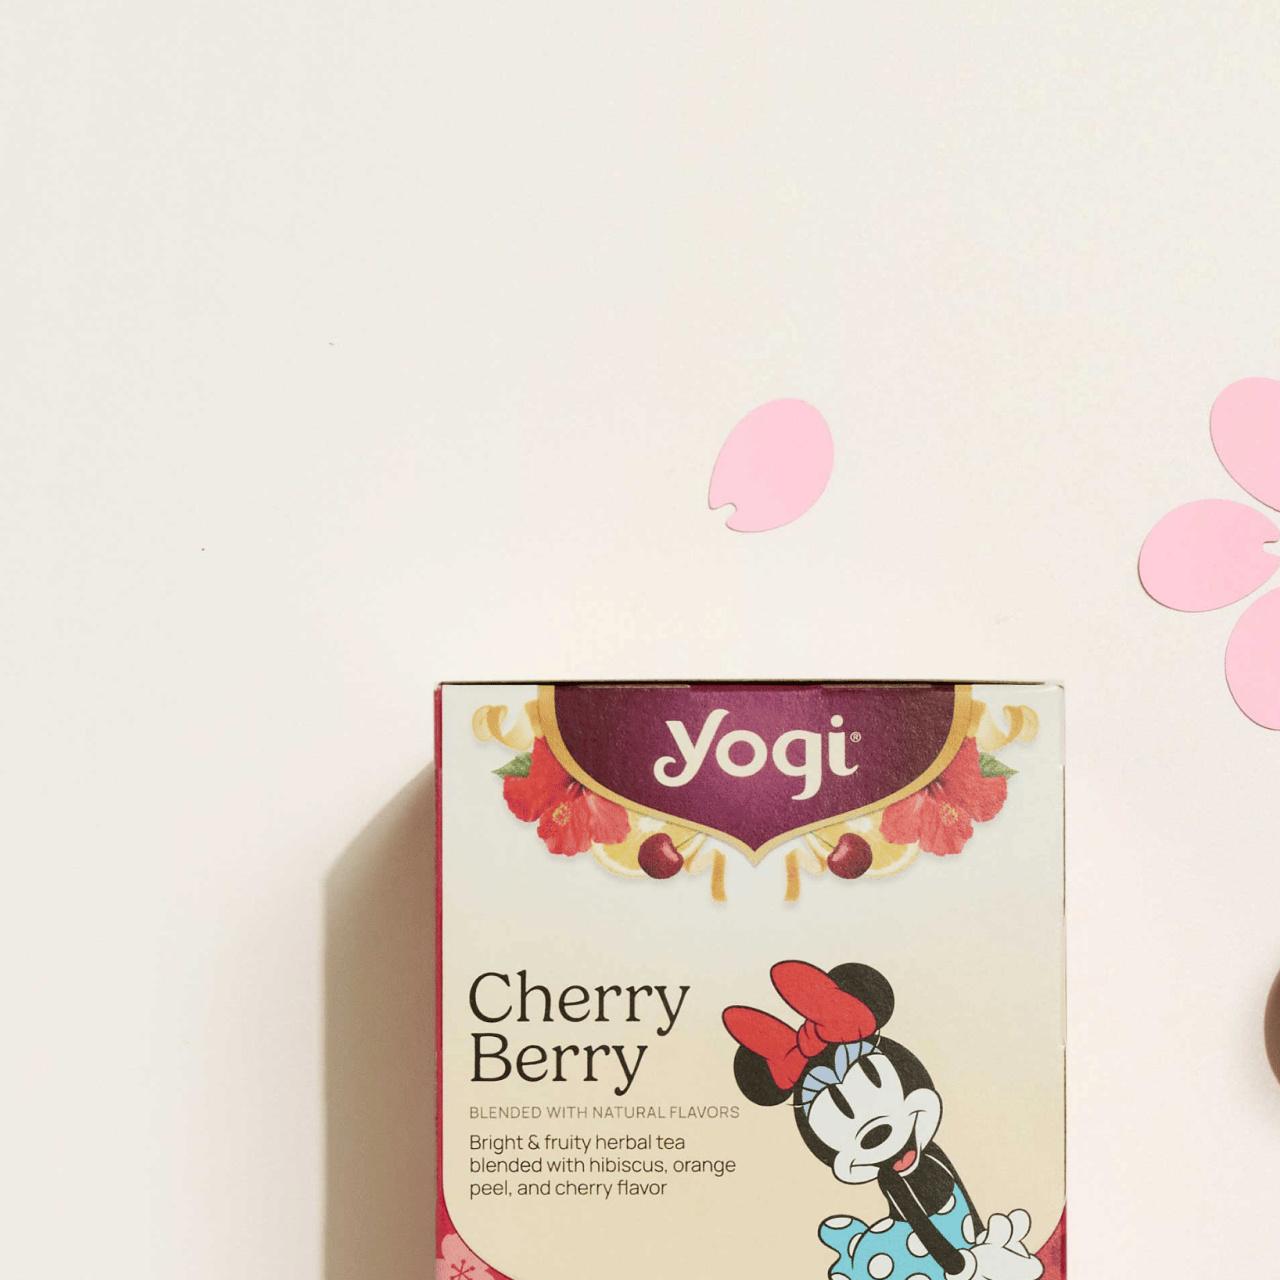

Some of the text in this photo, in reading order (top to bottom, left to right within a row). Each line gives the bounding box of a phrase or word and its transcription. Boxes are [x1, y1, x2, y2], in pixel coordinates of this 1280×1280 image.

[468, 969, 691, 1037] Cherry
[470, 1032, 648, 1096] Berry
[469, 1105, 741, 1119] BLENDED WITH NATURAL FLAVORS
[469, 1133, 685, 1155] Bright & fruity herbal tea
[469, 1157, 737, 1177] blended with hibiscus, orange
[469, 1179, 668, 1200] peel, and cherry flavor
